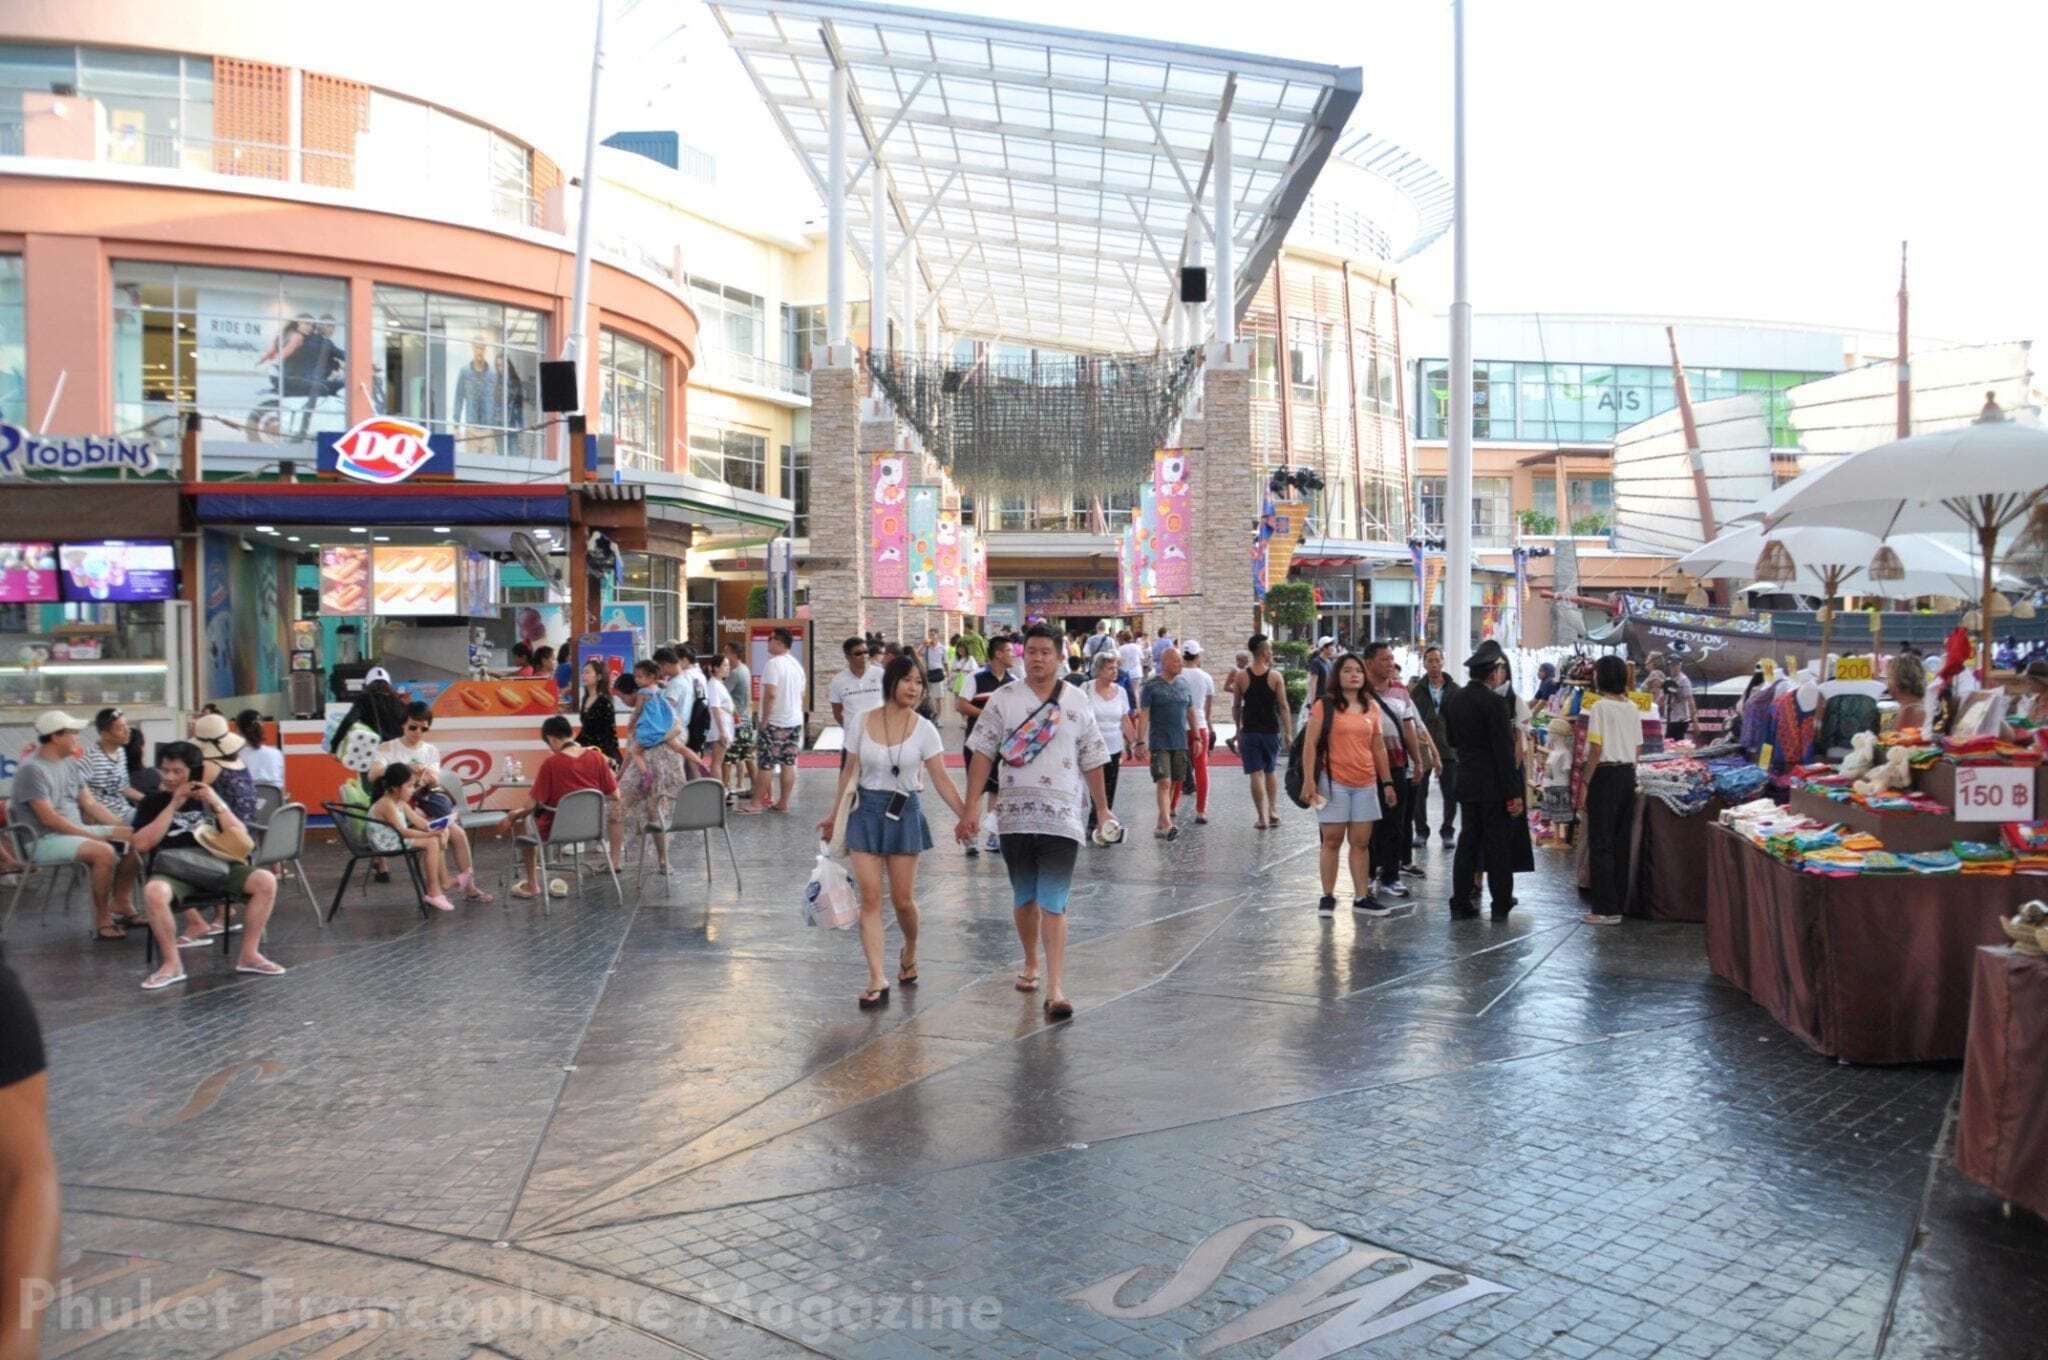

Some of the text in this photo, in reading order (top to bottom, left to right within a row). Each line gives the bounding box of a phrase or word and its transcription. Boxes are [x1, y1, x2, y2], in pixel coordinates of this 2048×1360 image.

[211, 320, 260, 335] RIDE ON
[1598, 391, 1640, 411] AIS
[350, 430, 418, 469] DQ
[1648, 626, 1721, 644] JUNGCEYLON
[1837, 664, 1871, 679] 200
[1959, 785, 2003, 806] 150
